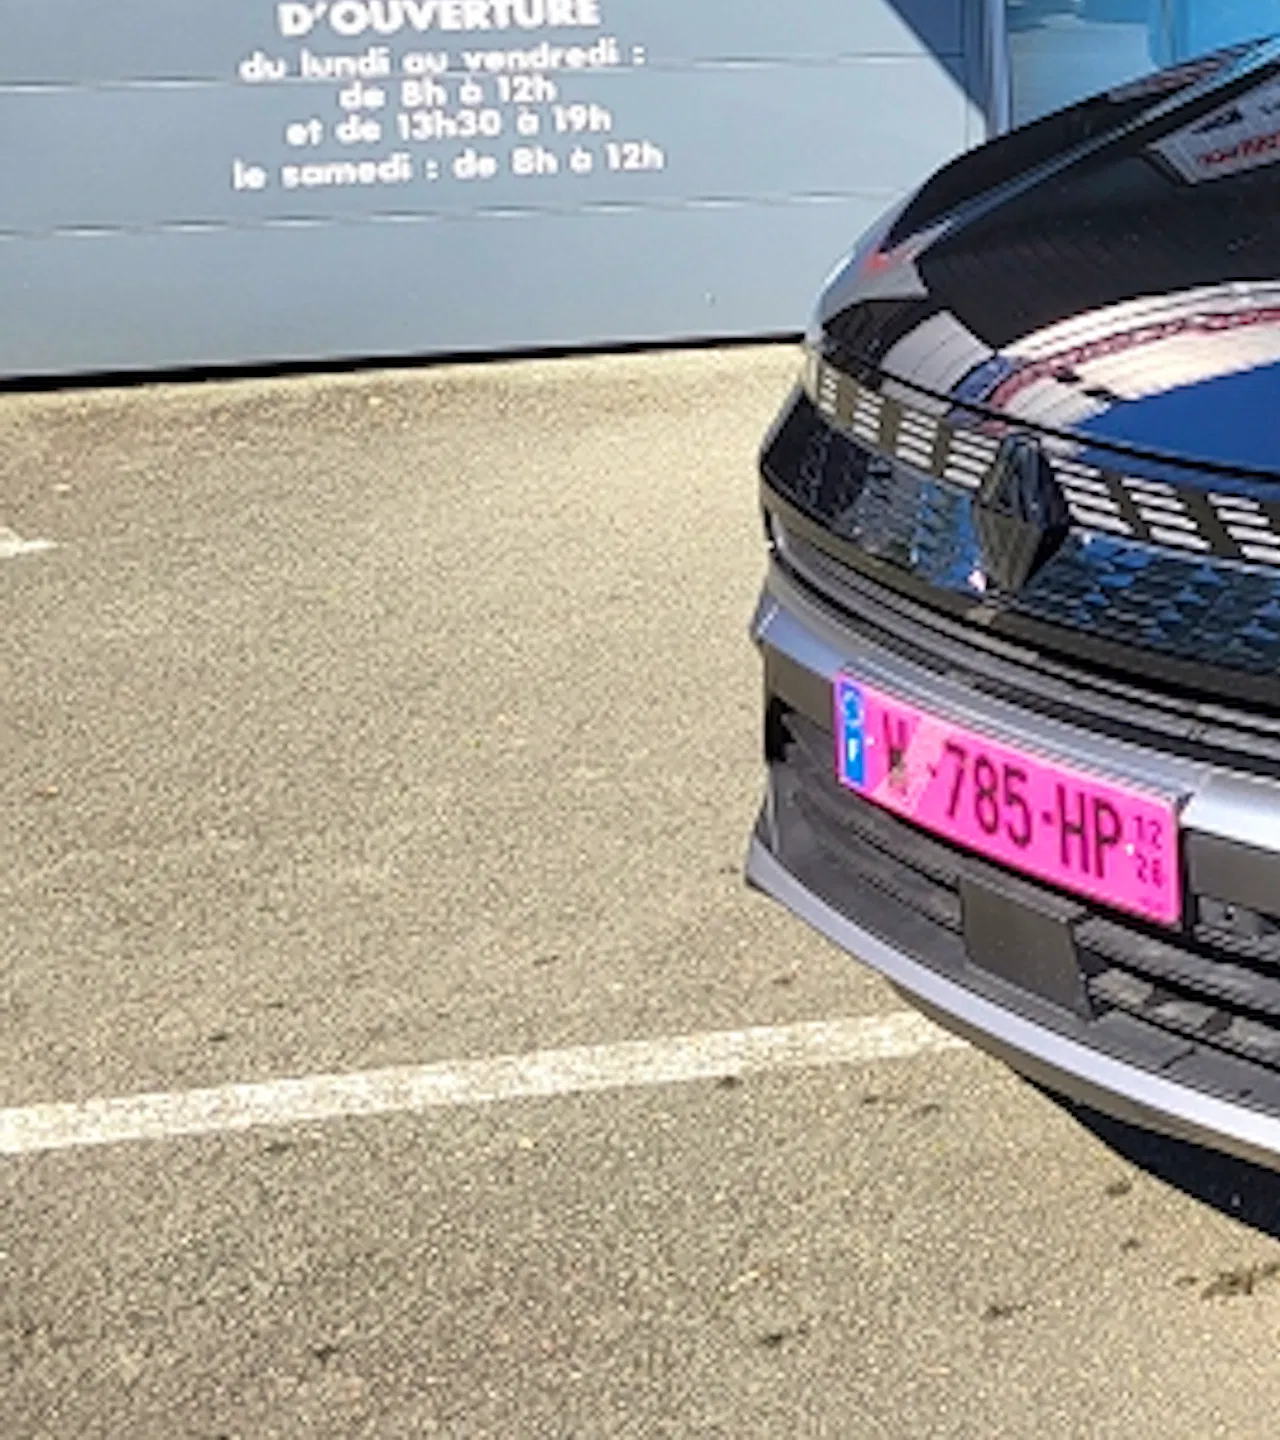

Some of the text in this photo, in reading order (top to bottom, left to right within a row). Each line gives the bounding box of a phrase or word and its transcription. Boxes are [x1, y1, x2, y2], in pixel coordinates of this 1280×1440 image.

[240, 38, 645, 82] du lundi au vendredi :
[340, 75, 556, 109] de 8h à 12h
[286, 104, 612, 147] et de 13h30 à 19h
[233, 142, 664, 190] le samedi : de 8h à 12h
